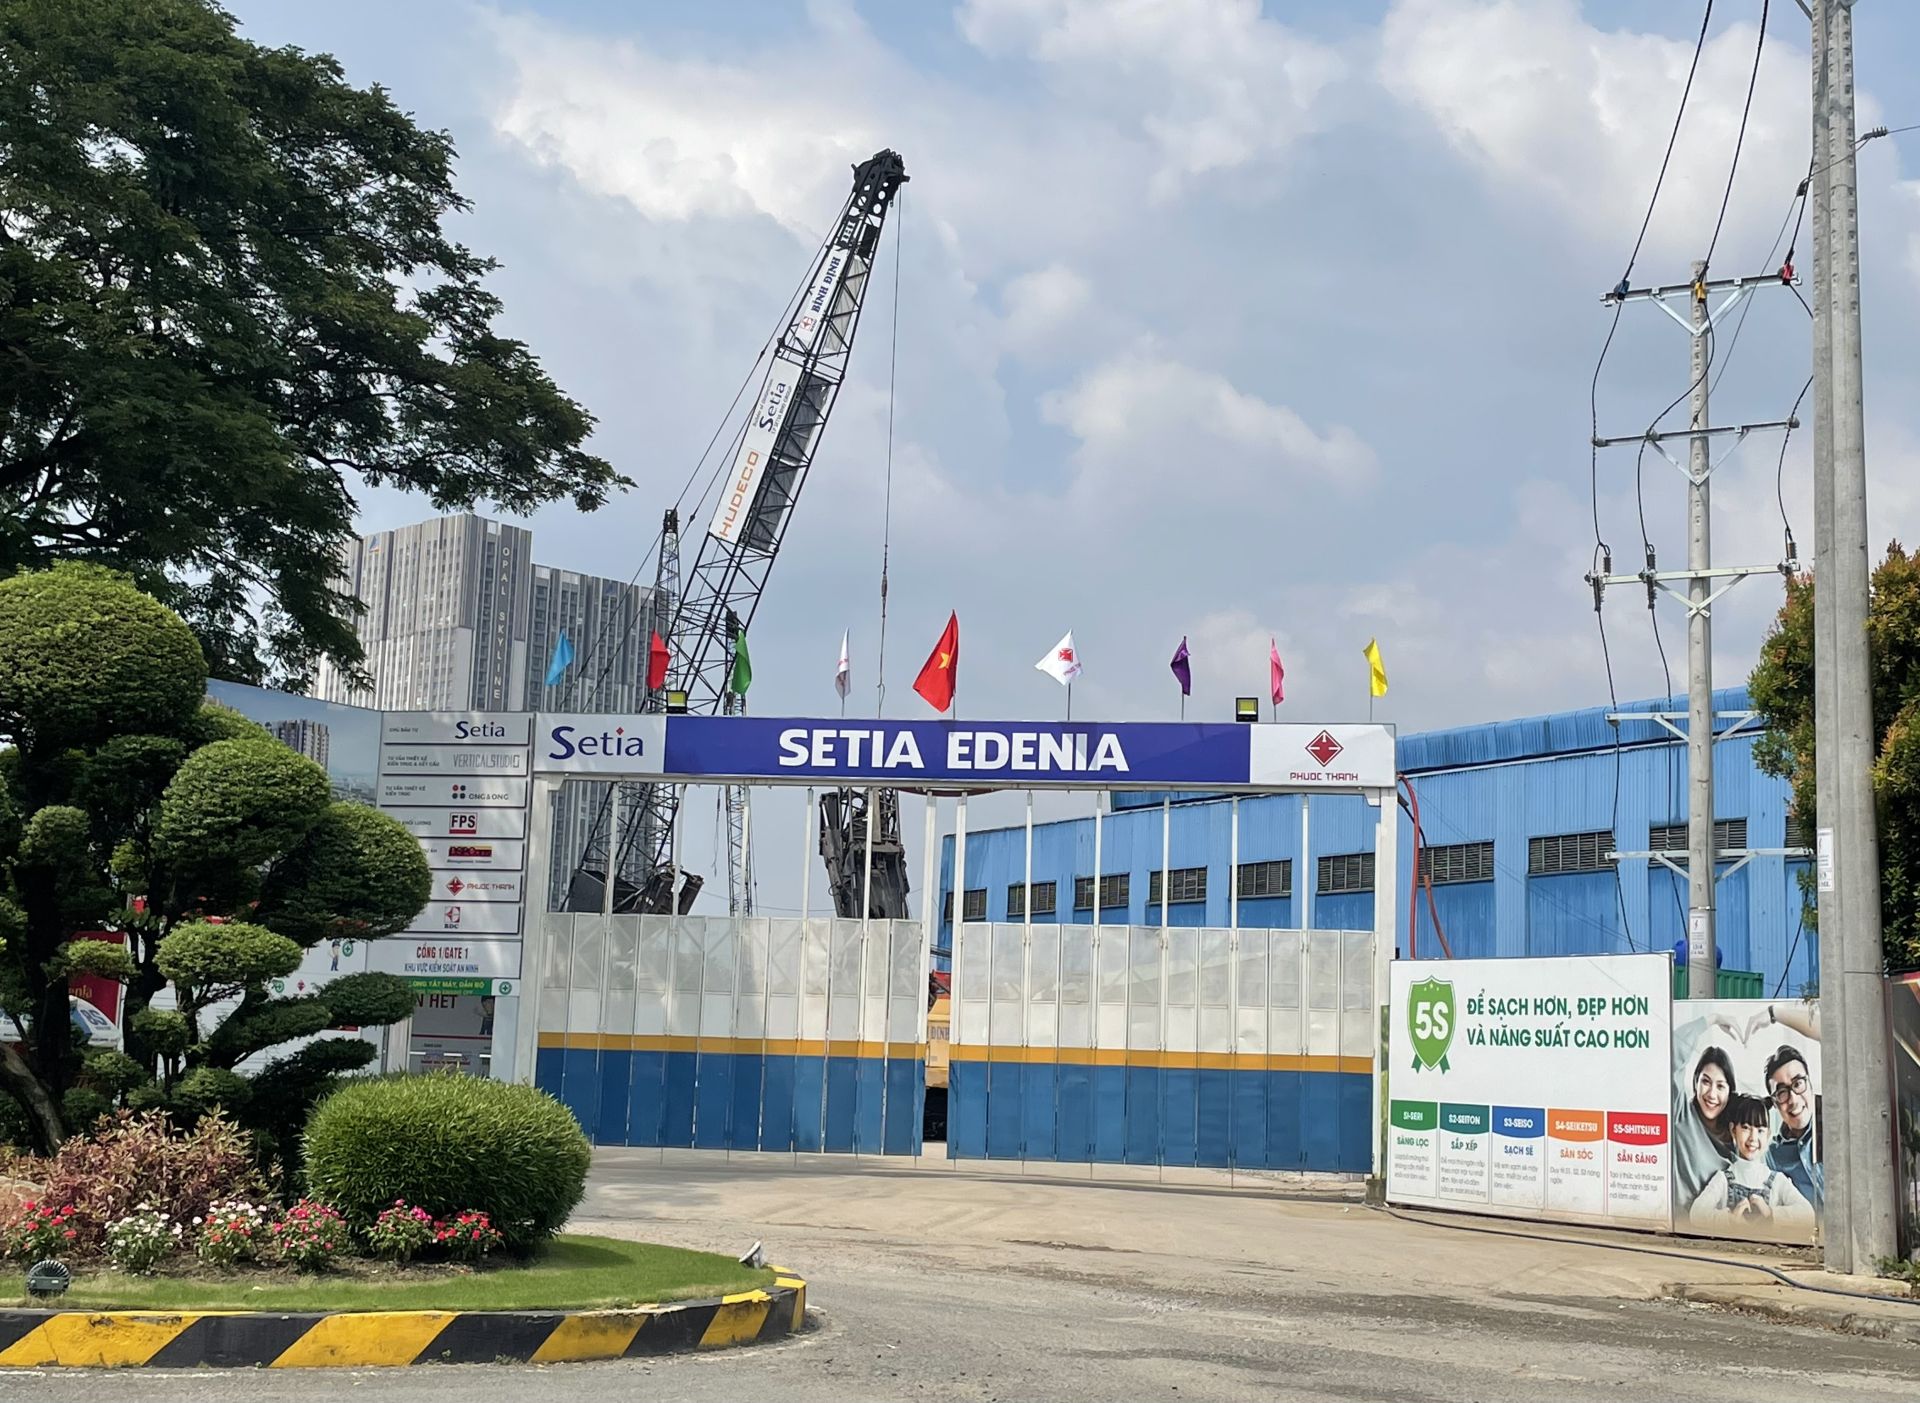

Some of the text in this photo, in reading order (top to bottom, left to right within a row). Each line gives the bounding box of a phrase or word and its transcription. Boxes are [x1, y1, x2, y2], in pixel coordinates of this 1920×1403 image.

[840, 219, 856, 244] IHI
[823, 257, 842, 284] ĐỊNH
[757, 381, 787, 432] Setia
[719, 451, 760, 537] HUDECO
[494, 547, 511, 699] OPAL SKYLINE
[455, 721, 505, 739] Setia
[549, 725, 644, 760] Setia
[779, 729, 1130, 772] SETIA EDENIA
[1325, 772, 1359, 781] THANH
[451, 815, 476, 828] FPS
[1467, 988, 1649, 1022] ĐỂ SẠCH HƠN, ĐẸP HƠN
[1415, 1001, 1449, 1040] 5S
[1467, 1021, 1650, 1048] VÀ NĂNG SUẤT CAO HƠN
[1416, 1138, 1429, 1149] LỌC
[1613, 1124, 1661, 1136] S5-SHITSUKE
[1504, 1145, 1524, 1157] SẠCH
[1577, 1148, 1593, 1160] SÓC
